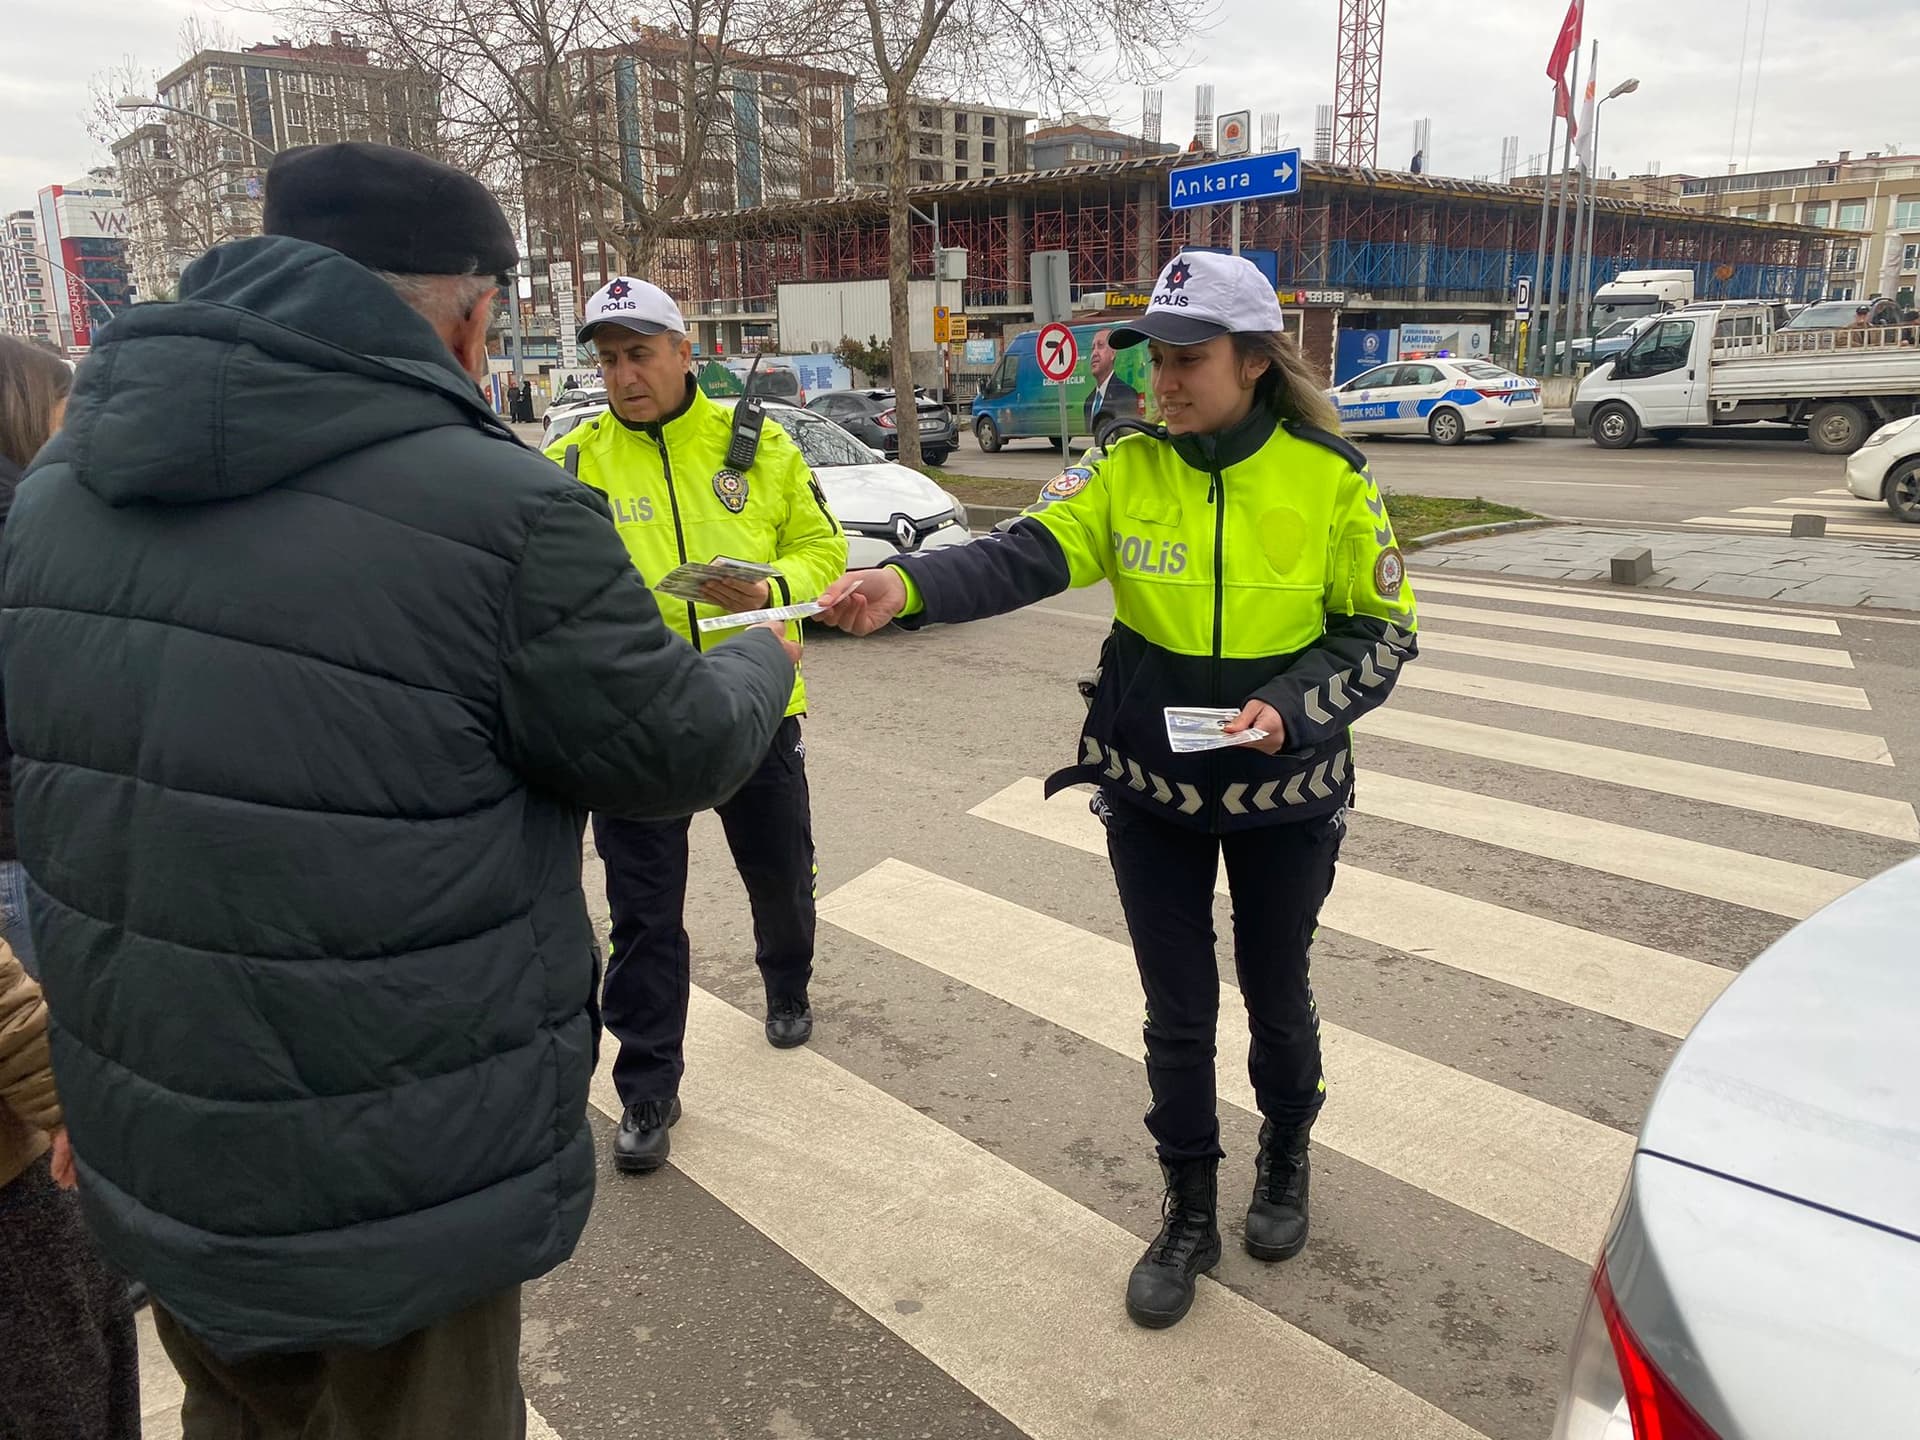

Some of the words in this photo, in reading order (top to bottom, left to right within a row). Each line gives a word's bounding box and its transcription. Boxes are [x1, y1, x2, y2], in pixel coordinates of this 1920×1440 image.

[1175, 173, 1250, 198] Ankara
[1519, 285, 1528, 304] D
[609, 497, 654, 523] LiS
